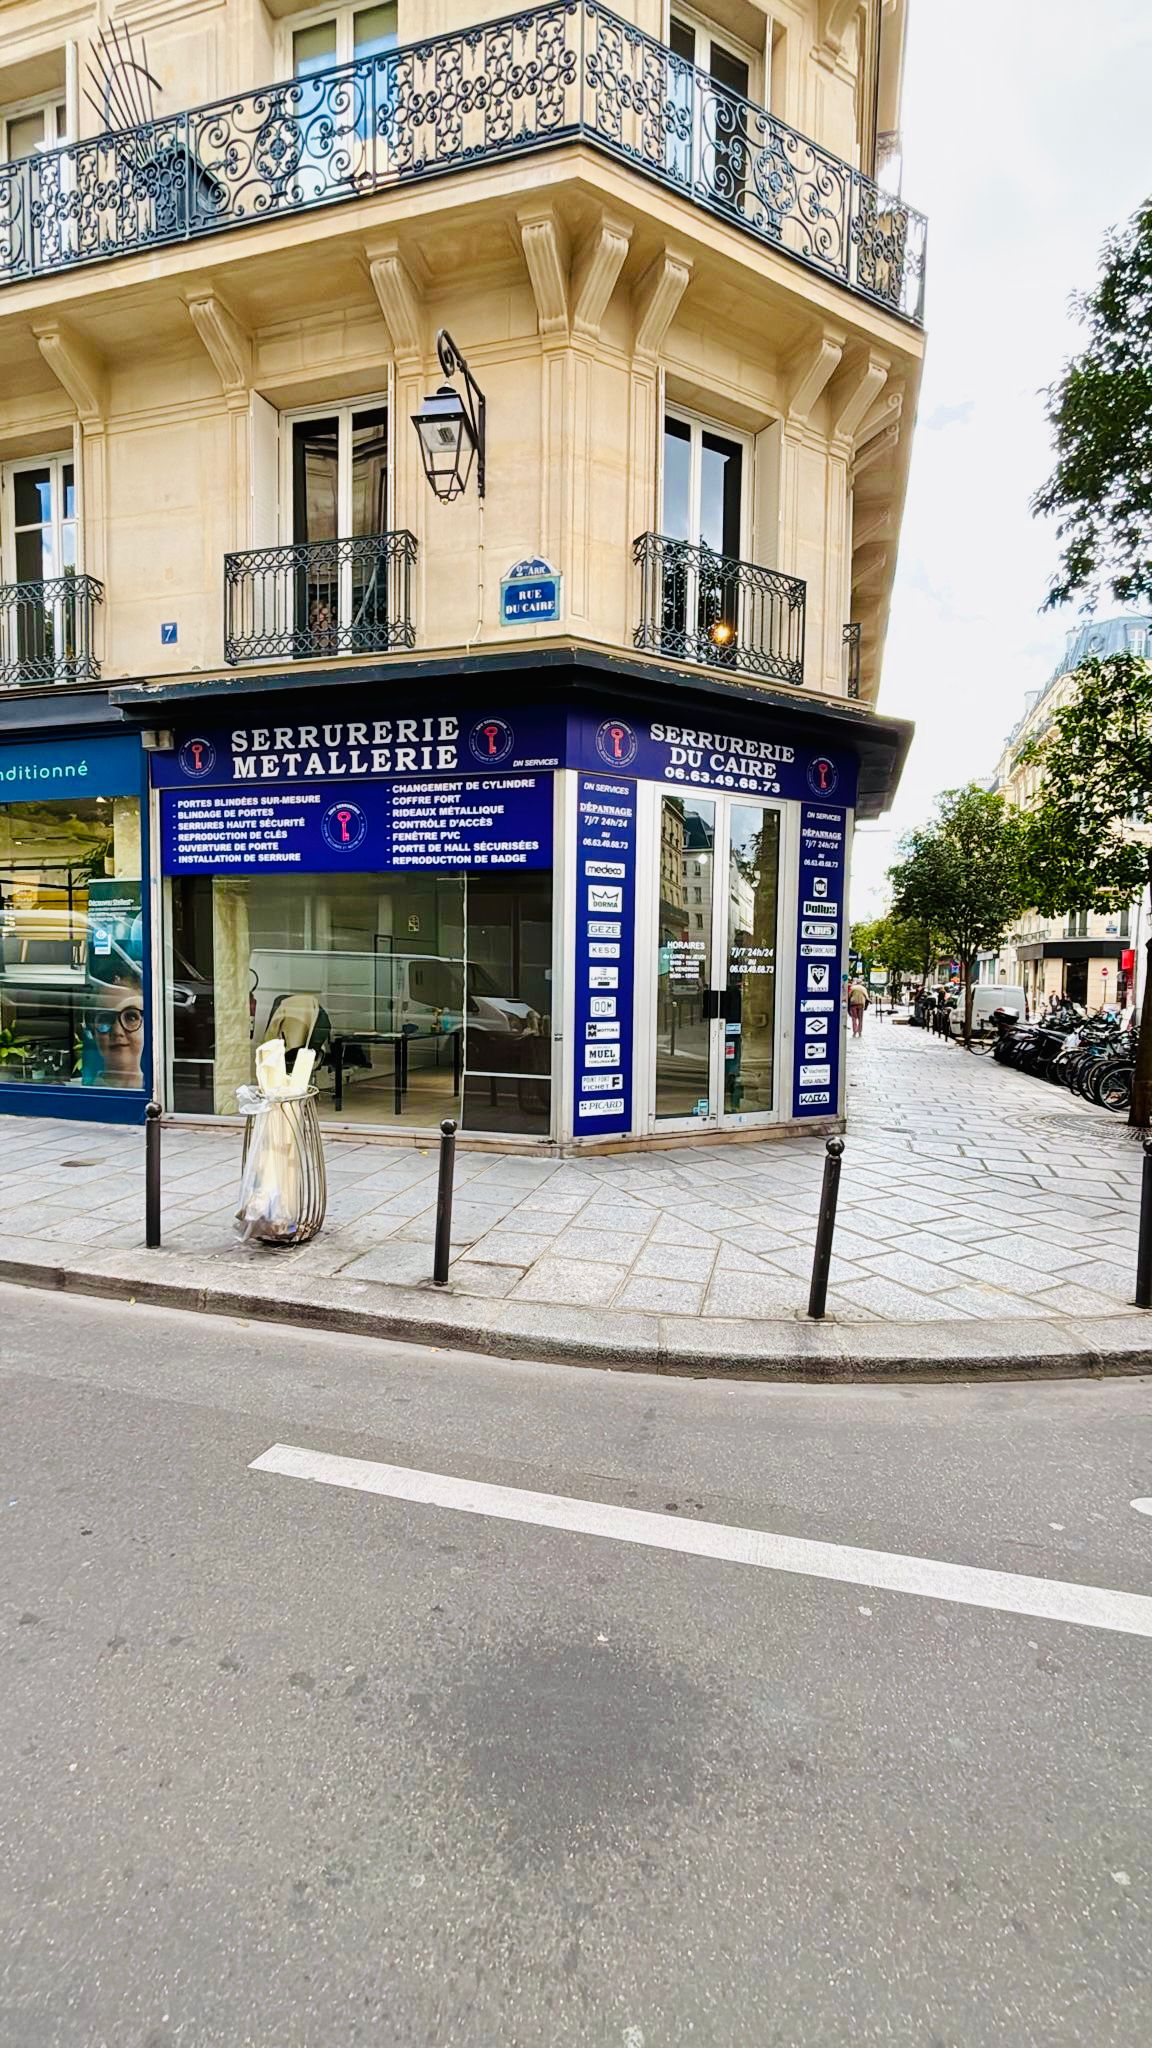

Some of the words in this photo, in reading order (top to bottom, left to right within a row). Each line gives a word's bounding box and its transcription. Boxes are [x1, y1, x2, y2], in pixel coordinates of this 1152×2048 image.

[519, 589, 542, 600] RUE
[506, 604, 520, 614] DU
[522, 600, 555, 612] CAIRE
[165, 625, 173, 642] 7
[231, 716, 460, 752] SERRURERIE
[650, 723, 795, 763] SERRURERIE
[233, 745, 458, 779] METALLERIE
[524, 758, 559, 766] SERVICES
[670, 747, 703, 768] DU
[709, 754, 777, 779] CAIRE
[665, 766, 781, 793] 06.63.49.68.73
[392, 783, 463, 793] CHANGEMENT
[466, 782, 479, 790] DE
[482, 779, 536, 789] CYLINDRE
[583, 782, 595, 790] DN
[595, 784, 629, 795] SERVICES
[178, 799, 212, 808] PORTES
[214, 796, 259, 807] BLINDÉES
[261, 795, 321, 805] SUR-MESURE
[392, 796, 431, 805] COFFRE
[434, 795, 461, 804] FORT
[178, 809, 221, 819] BLINDAGE
[224, 809, 236, 818] DE
[238, 808, 274, 817] PORTES
[392, 808, 436, 817] RIDEAUX
[439, 805, 504, 816] MÉTALLIQUE
[580, 801, 632, 816] DÉPANNAGE
[601, 817, 627, 827] 24h/24
[816, 813, 841, 821] SERVICES
[178, 821, 224, 830] SERRURES
[226, 820, 257, 829] HAUTE
[259, 817, 305, 828] SÉCURITÉ
[392, 818, 446, 829] CONTRÔLE
[178, 832, 247, 841] REPRODUCTION
[264, 830, 288, 839] CLÉS
[392, 831, 438, 841] FENÊTRE
[441, 832, 460, 840] PVC
[802, 828, 842, 840] DÉPANNAGE
[178, 843, 232, 852] OUVERTURE
[234, 843, 246, 851] DE
[249, 842, 279, 850] PORTE
[392, 844, 426, 853] PORTE
[428, 844, 441, 852] DE
[444, 843, 471, 851] HALL
[473, 840, 539, 851] SÉCURISÉES
[179, 854, 241, 863] INSTALLATION
[244, 854, 256, 862] DE
[258, 853, 301, 862] SERRURE
[392, 855, 471, 865] REPRODUCTION
[474, 855, 488, 863] DE
[491, 854, 527, 863] BADGE
[593, 900, 618, 908] DORMA
[590, 925, 618, 934] GEZE
[592, 946, 617, 954] KESO
[667, 941, 705, 950] HORAIRES
[747, 948, 774, 957] 24h/24
[589, 1049, 615, 1058] MUEL
[801, 1093, 827, 1103] KABA
[589, 1101, 622, 1109] PICARD
